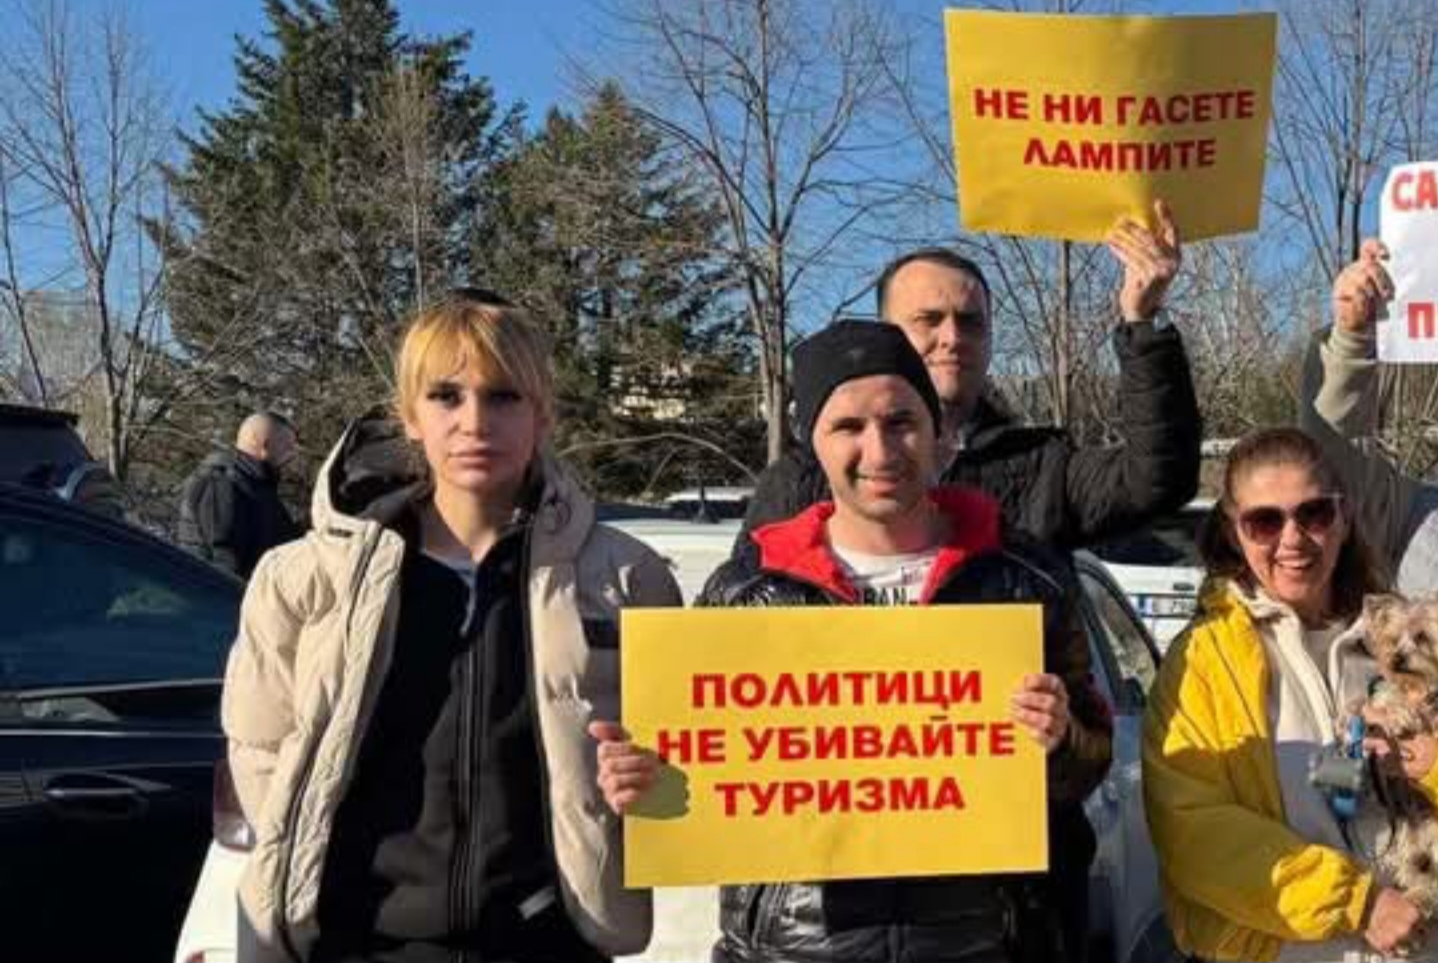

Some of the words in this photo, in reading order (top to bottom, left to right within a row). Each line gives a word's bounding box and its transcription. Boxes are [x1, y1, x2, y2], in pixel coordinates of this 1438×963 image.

[972, 88, 1029, 120] НЕ
[1043, 94, 1103, 126] НИ
[1116, 91, 1255, 126] ГАСЕТЕ
[1023, 138, 1217, 172] ЛАМПИТЕ
[691, 670, 984, 711] ПОЛИТИЦИ
[657, 727, 727, 765] НЕ
[744, 715, 1016, 763] УБИВАЙТЕ
[713, 776, 966, 817] ТУРИЗМА
